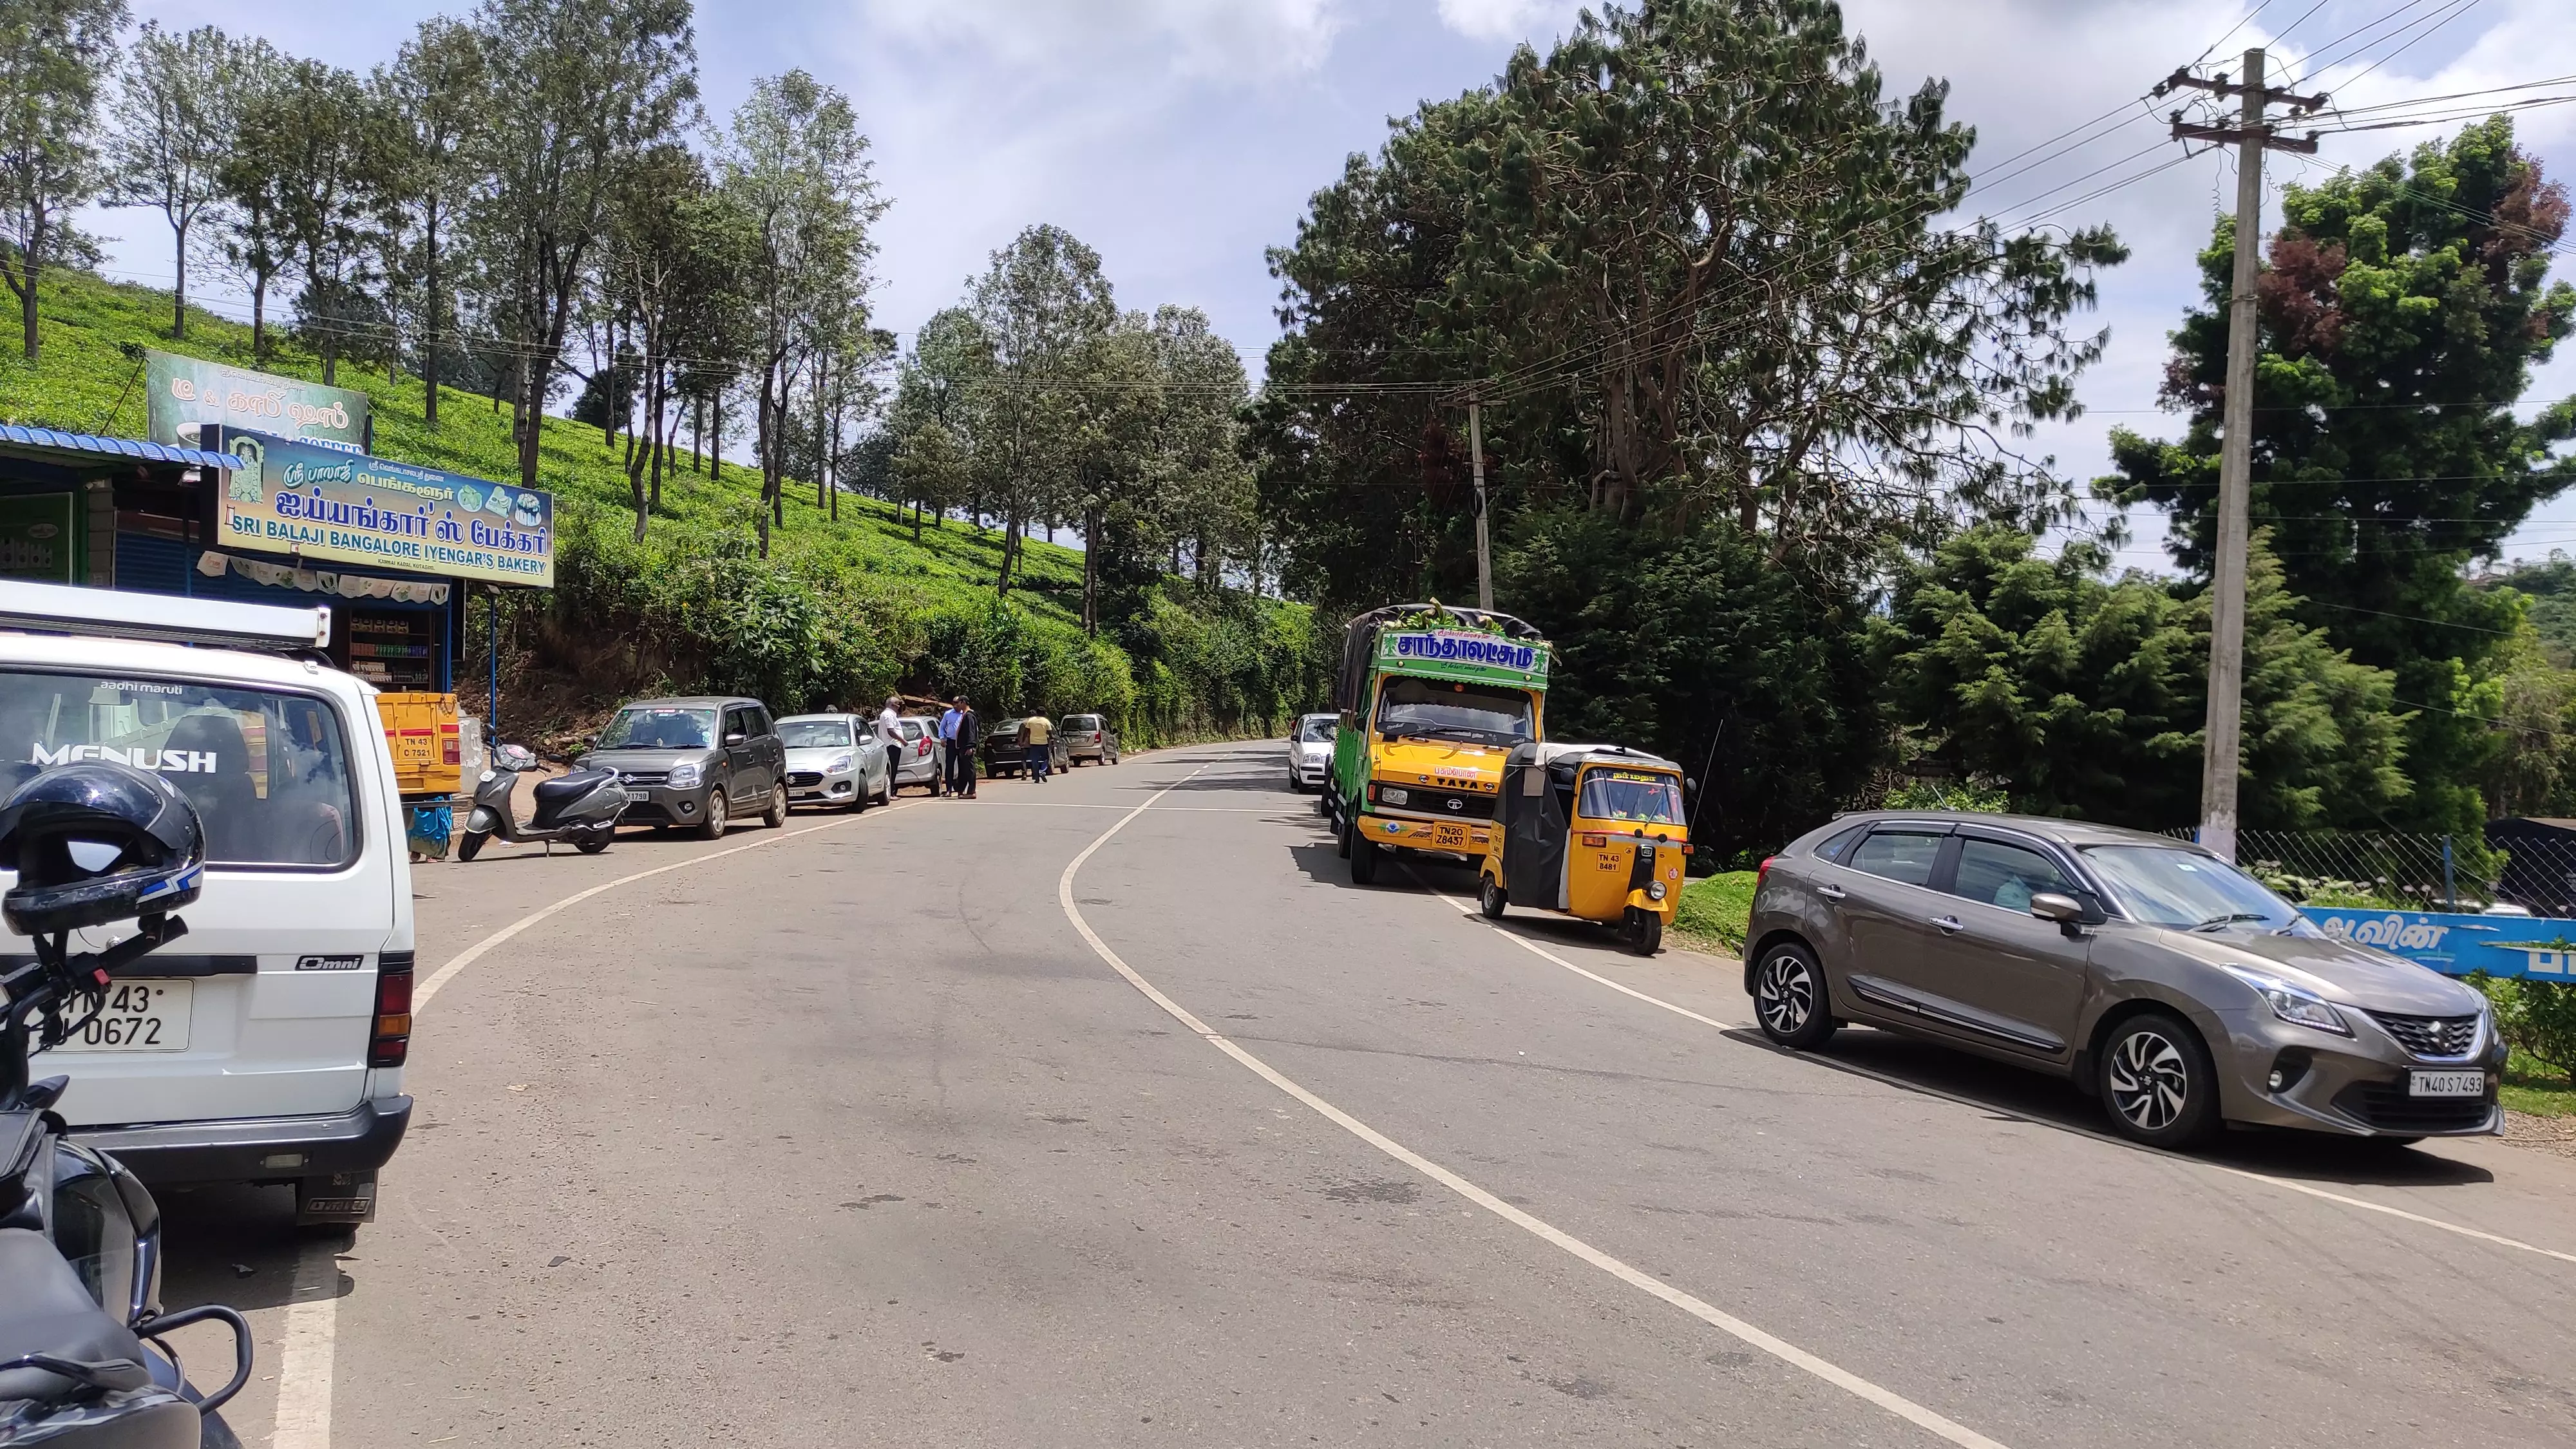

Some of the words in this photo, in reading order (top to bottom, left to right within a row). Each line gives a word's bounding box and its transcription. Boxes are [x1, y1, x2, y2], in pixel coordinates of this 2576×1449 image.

[204, 390, 219, 406] &
[307, 459, 354, 484] பாலாஜி
[357, 472, 455, 501] பெங்களூர்
[232, 516, 261, 537] SRI
[266, 520, 325, 546] BALAJI
[330, 531, 421, 558] BANGALORE
[424, 545, 494, 569] IYENGAR'S
[498, 556, 547, 575] BAKERY
[470, 520, 547, 556] பேக்கரி
[100, 681, 137, 692] aadhi
[140, 683, 182, 695] maruti
[32, 743, 217, 773] MENUSH
[1437, 778, 1479, 790] TATA
[1439, 827, 1463, 836] TN20
[299, 957, 361, 969] Omni
[111, 986, 149, 1013] 43
[84, 1018, 162, 1045] 0672
